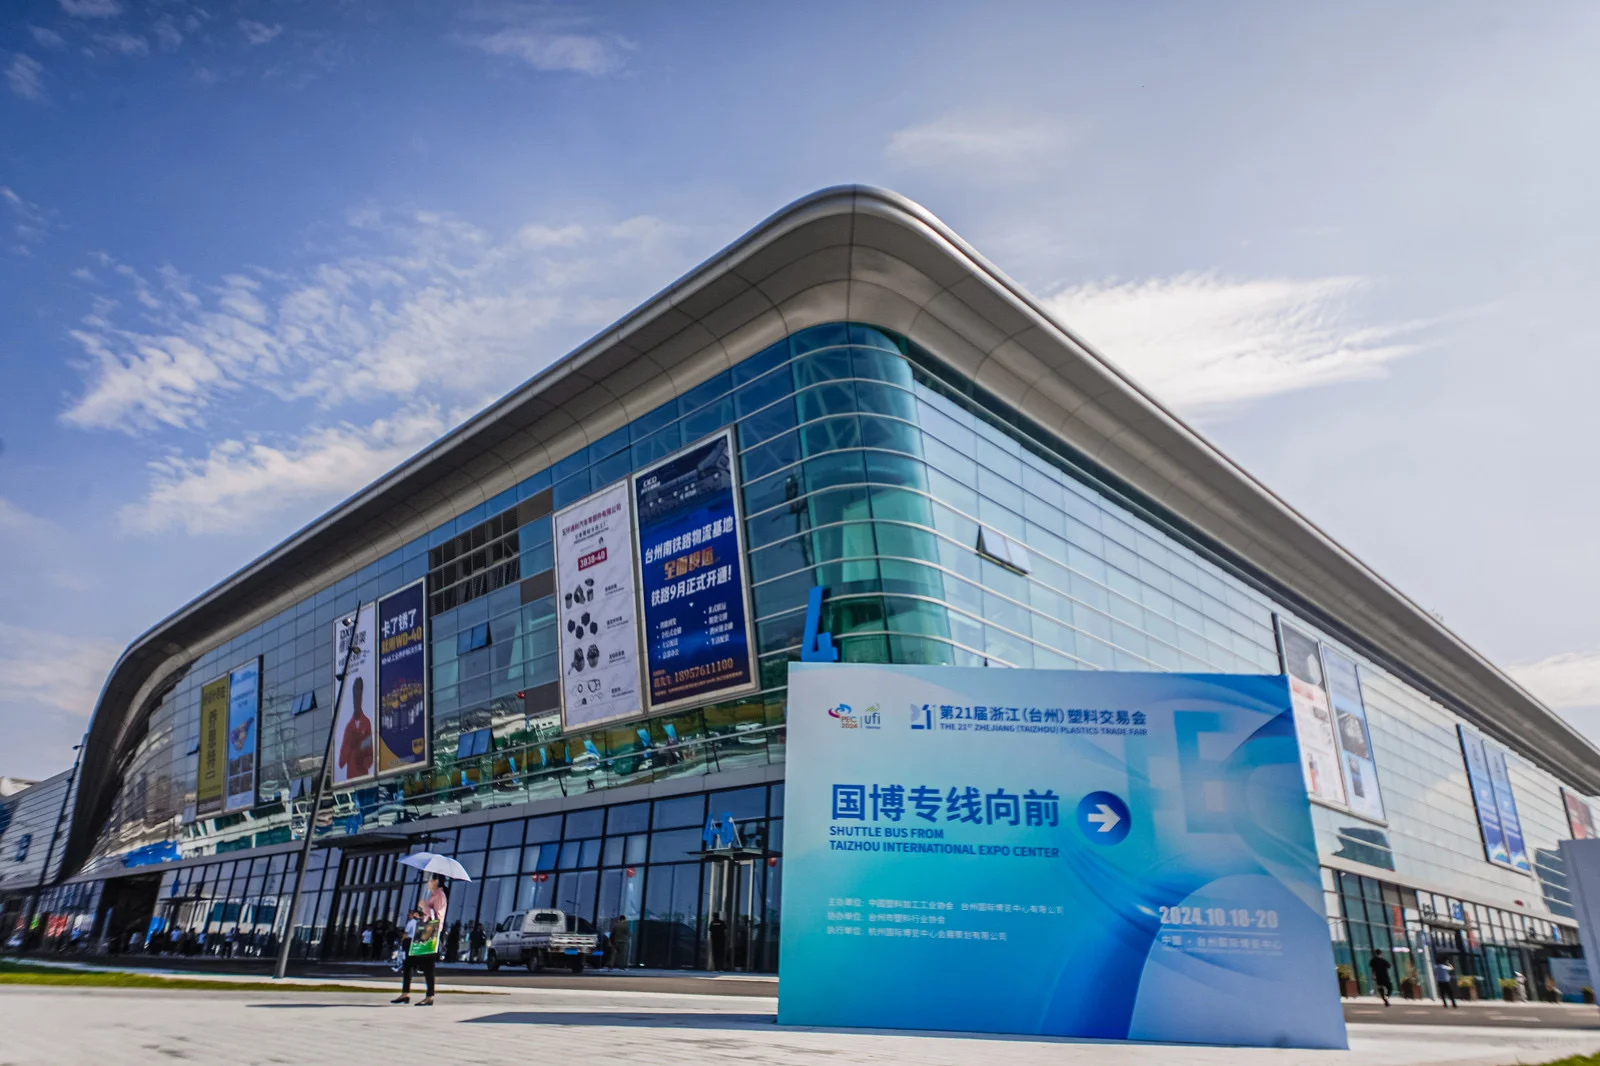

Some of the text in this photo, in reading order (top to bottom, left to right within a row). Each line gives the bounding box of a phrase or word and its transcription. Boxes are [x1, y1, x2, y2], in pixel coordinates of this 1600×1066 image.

[645, 515, 733, 564] 台州南铁路物流基地
[382, 608, 417, 638] 卡了锈了
[864, 712, 881, 725] ufi
[940, 723, 955, 731] THE
[974, 724, 1014, 732] ZHEJIANG
[1016, 725, 1059, 735] (TAIZHOU)
[1060, 726, 1099, 735] PLASTICS
[1101, 728, 1126, 736] TRADE
[1129, 728, 1148, 736] FAIR
[832, 784, 1060, 827] 国博专线向前
[829, 826, 944, 839] SHUTTLE BUS FROM
[829, 840, 1060, 858] TAIZHOU INTERNATIONAL EXPO CENTER
[1159, 906, 1279, 928] 2024.10.18-20
